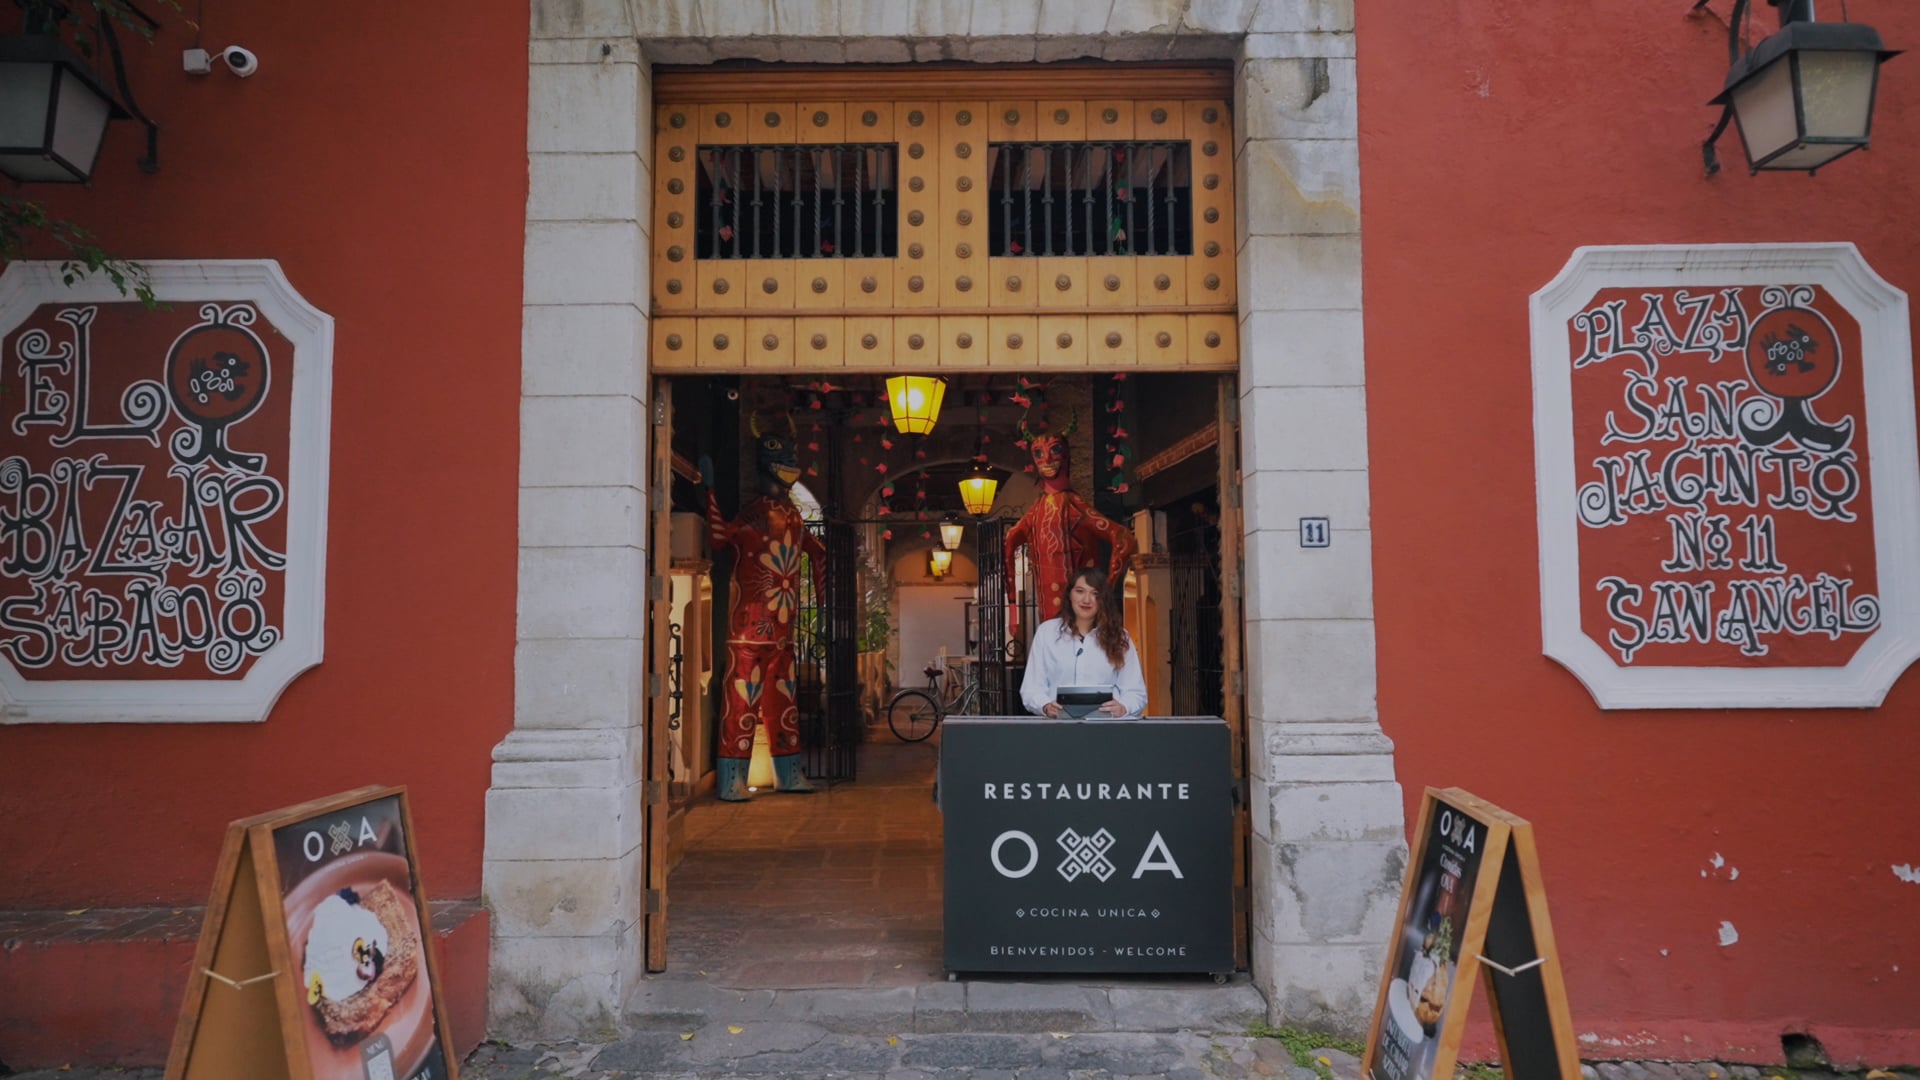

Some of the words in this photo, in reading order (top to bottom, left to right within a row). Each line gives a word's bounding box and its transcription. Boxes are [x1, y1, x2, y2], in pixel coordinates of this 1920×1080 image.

[1574, 287, 1749, 376] PLAZA
[12, 305, 172, 447] EL
[1601, 370, 1749, 445] SAN
[0, 455, 287, 583] BAZAAR
[1577, 443, 1859, 528] JACINTO
[1306, 523, 1324, 543] 11
[1736, 515, 1788, 573] 11
[0, 576, 281, 674] SABADO
[1598, 577, 1715, 662] SAN
[1717, 574, 1880, 655] ANGEL
[984, 783, 1190, 800] RESTAURANTE
[990, 946, 1095, 956] BIENVENIDOS
[1114, 946, 1187, 956] WELCOME
[1030, 908, 1089, 917] COCINA
[1098, 908, 1147, 917] UNICA
